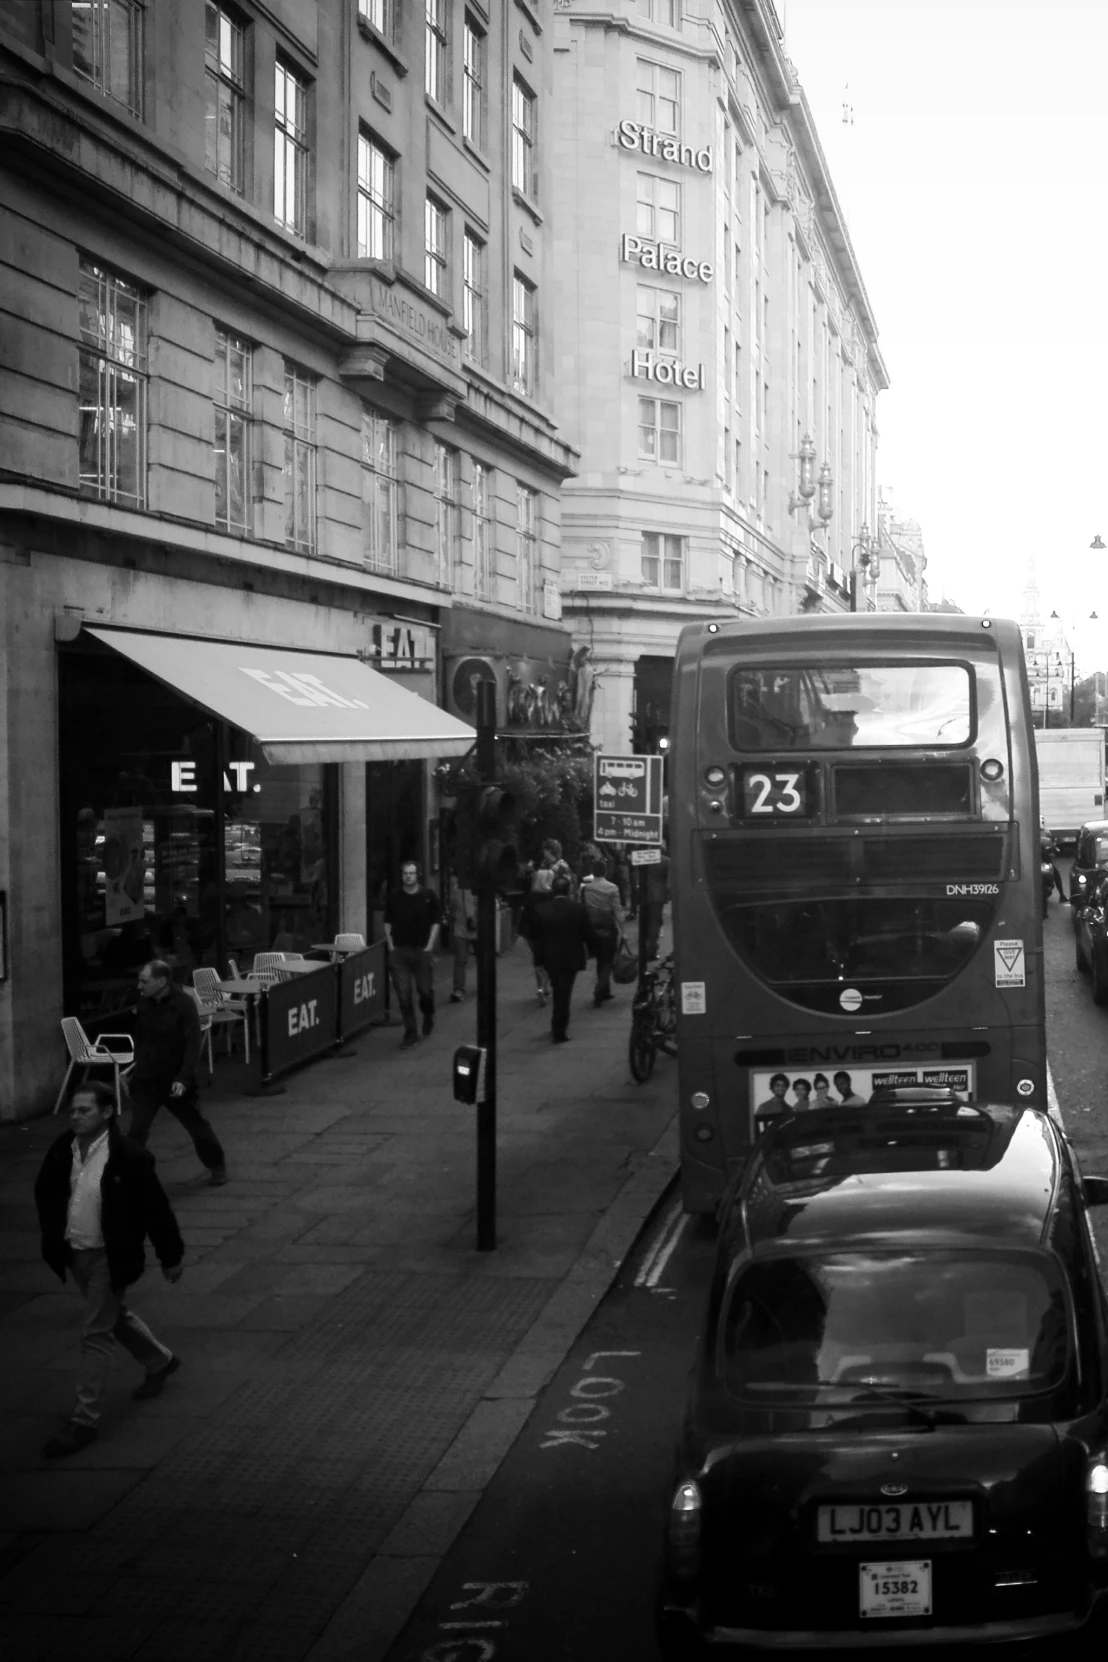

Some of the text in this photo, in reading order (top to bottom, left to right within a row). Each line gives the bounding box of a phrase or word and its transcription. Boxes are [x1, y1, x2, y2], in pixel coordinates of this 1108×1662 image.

[619, 119, 713, 174] Strand
[622, 233, 713, 283] Palace
[379, 283, 456, 359] MANFIELD HOUSE
[632, 350, 705, 390] Hotel
[238, 667, 370, 709] EAT.
[171, 761, 261, 793] ET.
[749, 773, 801, 813] 23
[599, 800, 615, 808] taxi
[623, 828, 659, 840] Midnight
[946, 884, 999, 895] DNH39126
[354, 972, 376, 1005] EAT.
[288, 999, 320, 1037] EAT.
[787, 1044, 901, 1063] ENVIRO
[925, 1072, 966, 1084] wellteen
[538, 1350, 643, 1450] LOOK
[828, 1504, 961, 1536] LJ03 AYL
[873, 1580, 919, 1596] 15382
